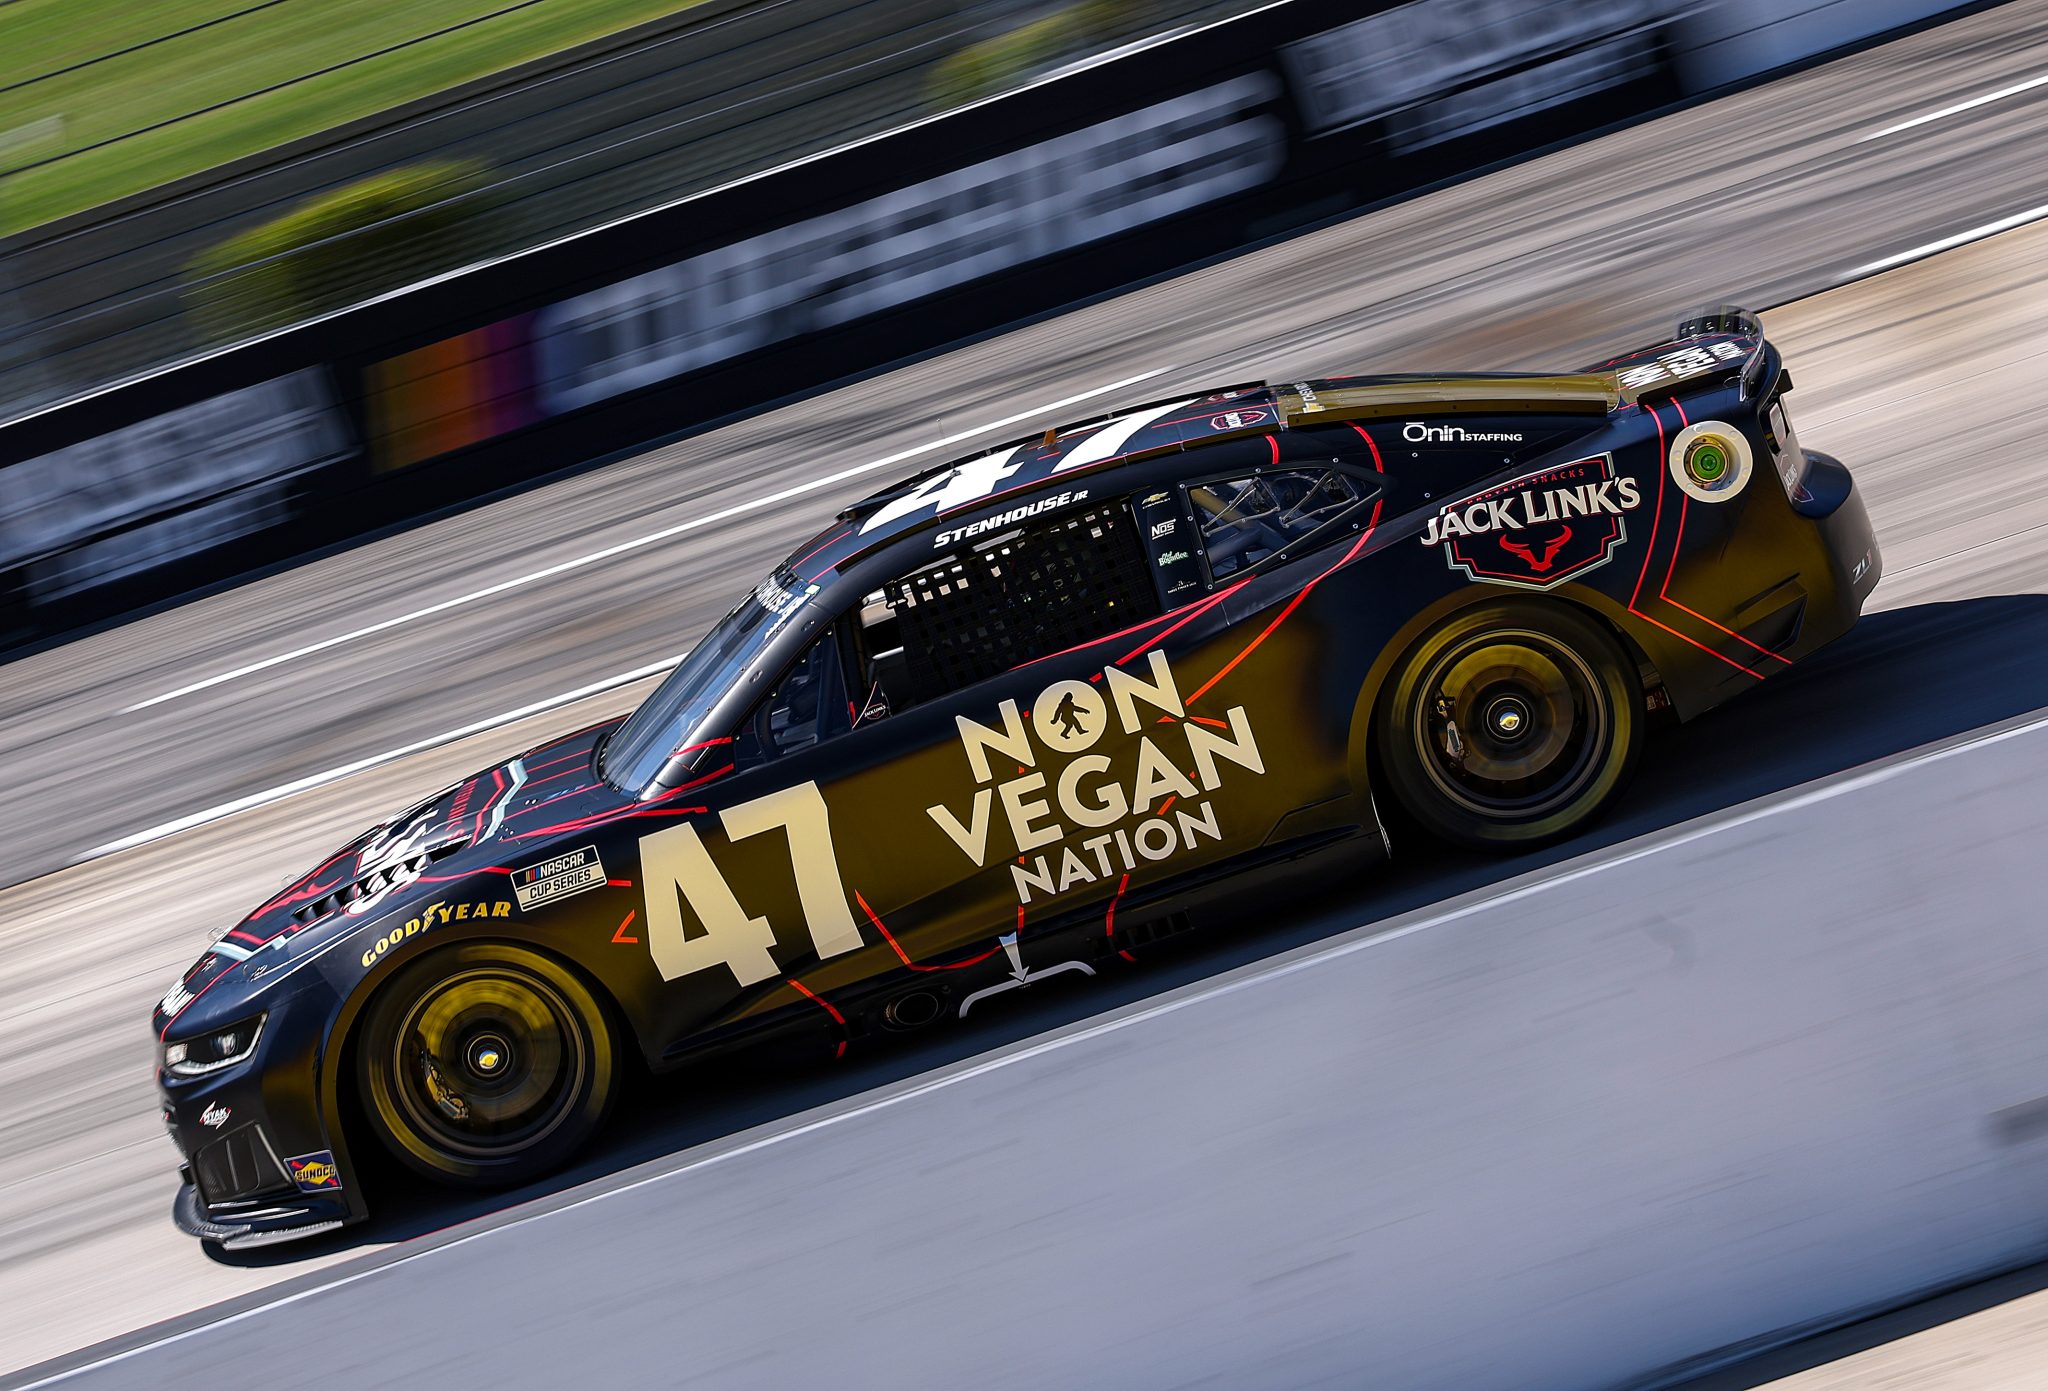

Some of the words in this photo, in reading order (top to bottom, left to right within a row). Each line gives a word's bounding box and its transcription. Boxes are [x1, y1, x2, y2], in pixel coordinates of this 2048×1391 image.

[858, 398, 1199, 537] 47
[1465, 432, 1523, 442] STAFFING
[1531, 467, 1585, 485] SNACKS
[933, 491, 1072, 549] STENHOUSE
[1071, 489, 1089, 503] JR
[1151, 518, 1177, 538] NOS
[1420, 497, 1524, 547] JACK
[1521, 476, 1642, 526] LINK'S
[955, 649, 1186, 784] NON
[926, 705, 1265, 867] VEGAN
[530, 881, 552, 899] CUP
[553, 870, 592, 891] SERIES
[540, 852, 585, 879] NASCAR
[639, 780, 865, 988] 47
[1009, 801, 1222, 904] NATION
[361, 900, 512, 968] GOODYEAR
[294, 1164, 337, 1181] SUNOCO
